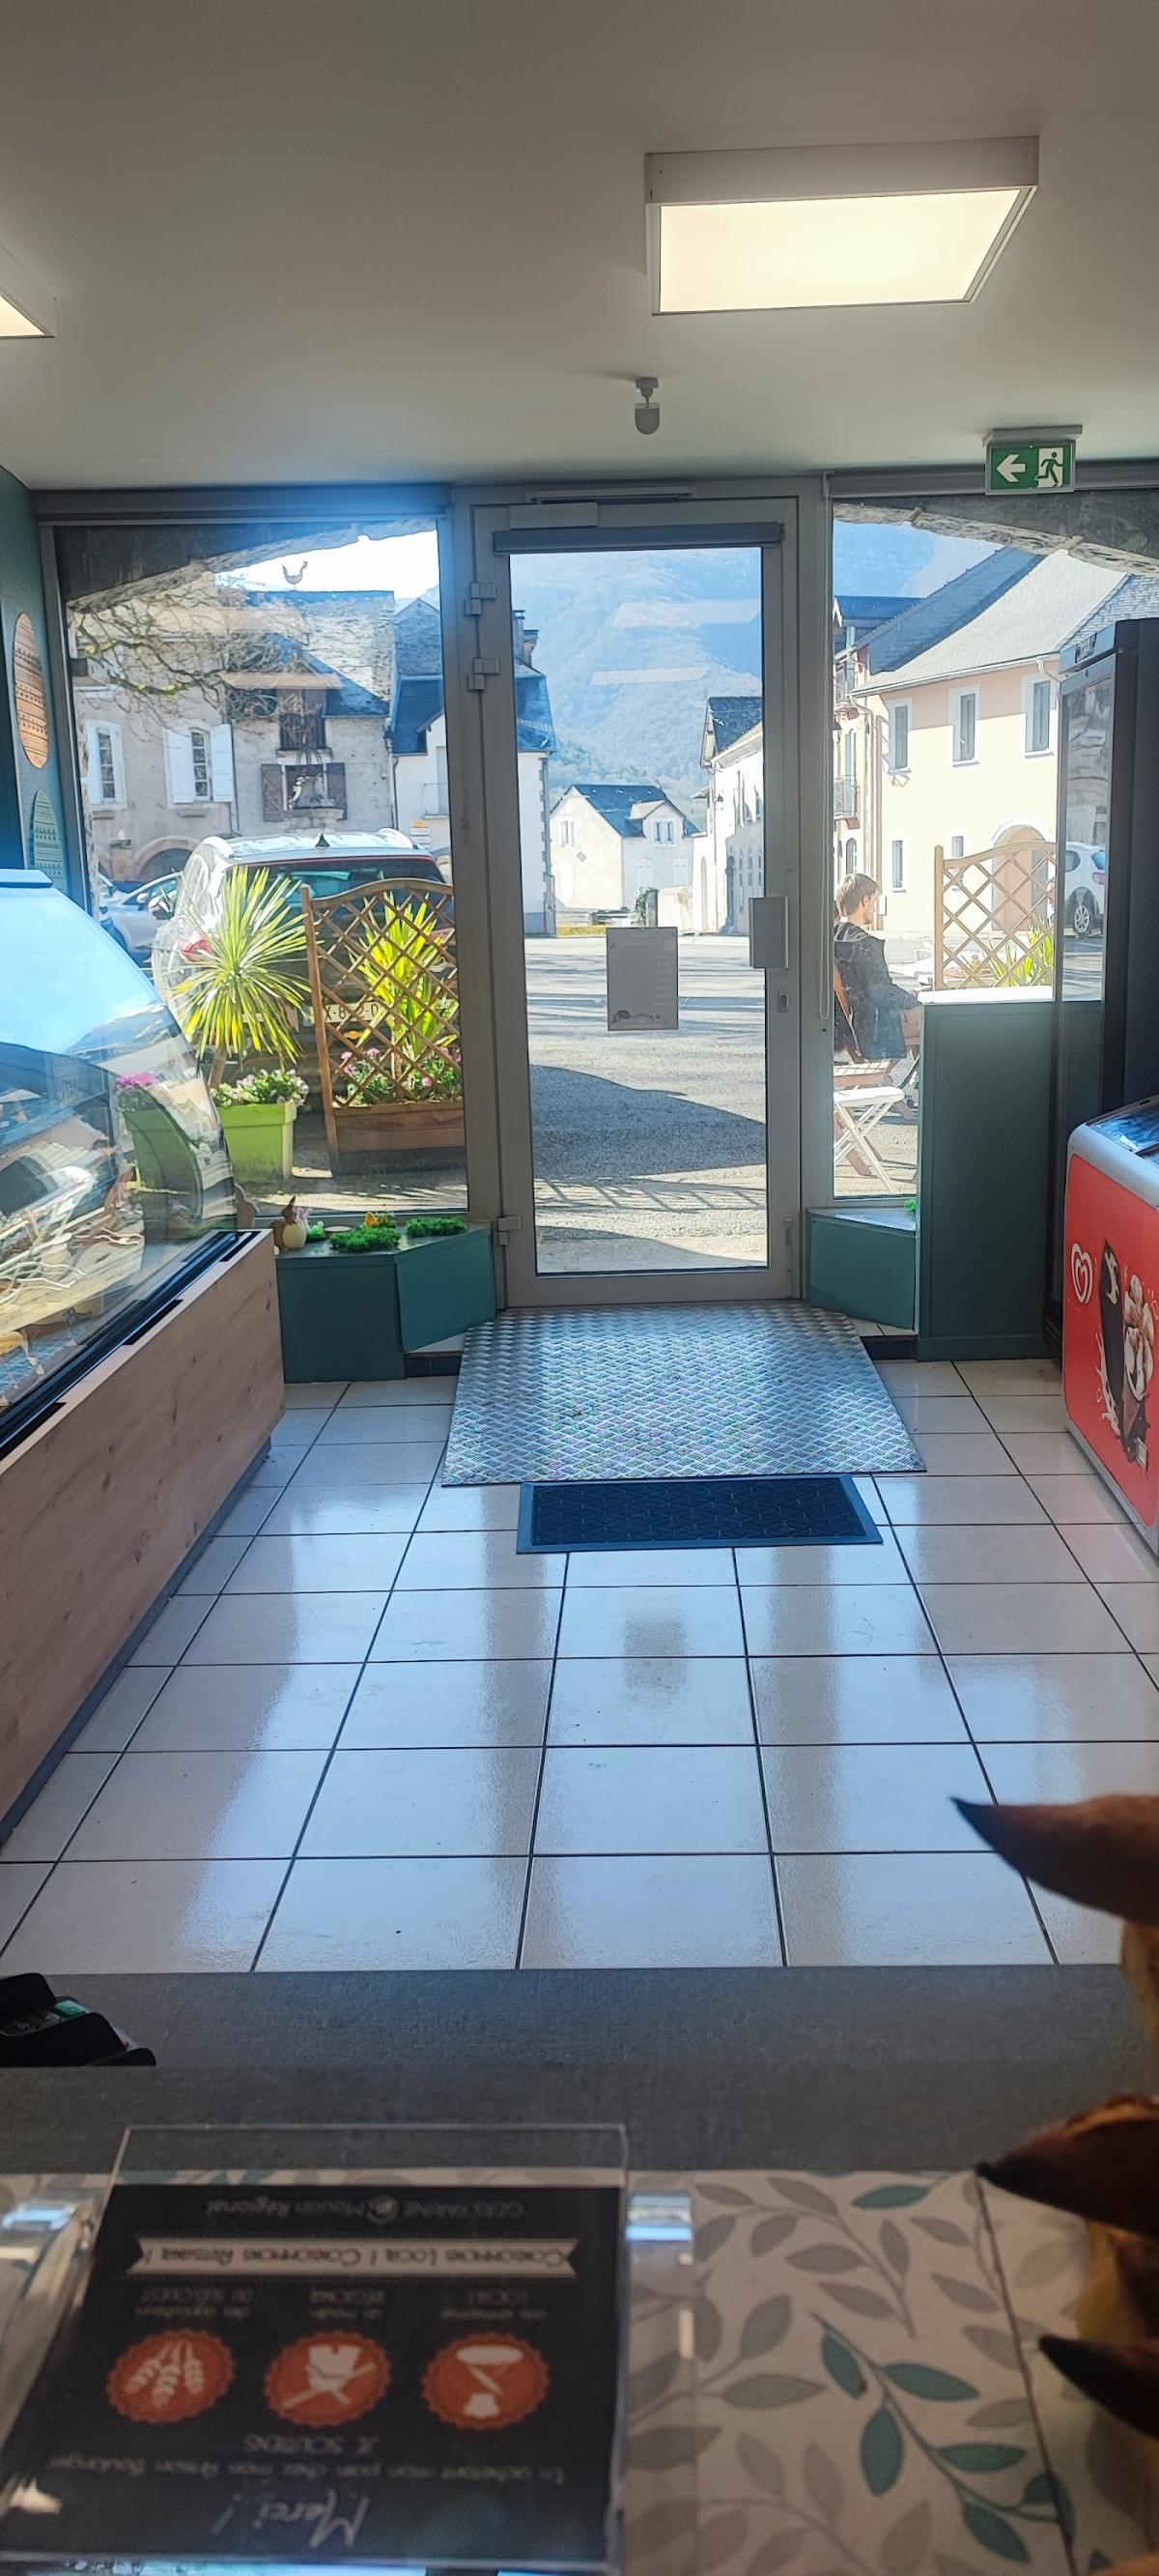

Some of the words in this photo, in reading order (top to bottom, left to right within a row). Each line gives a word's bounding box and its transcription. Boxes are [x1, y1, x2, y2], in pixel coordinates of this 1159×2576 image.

[205, 2194, 293, 2219] Régional
[242, 2433, 346, 2455] SOUTIENS
[280, 2461, 328, 2480] chez
[335, 2461, 382, 2480] pain
[212, 2494, 241, 2535] !
[254, 2490, 370, 2549] Merci
